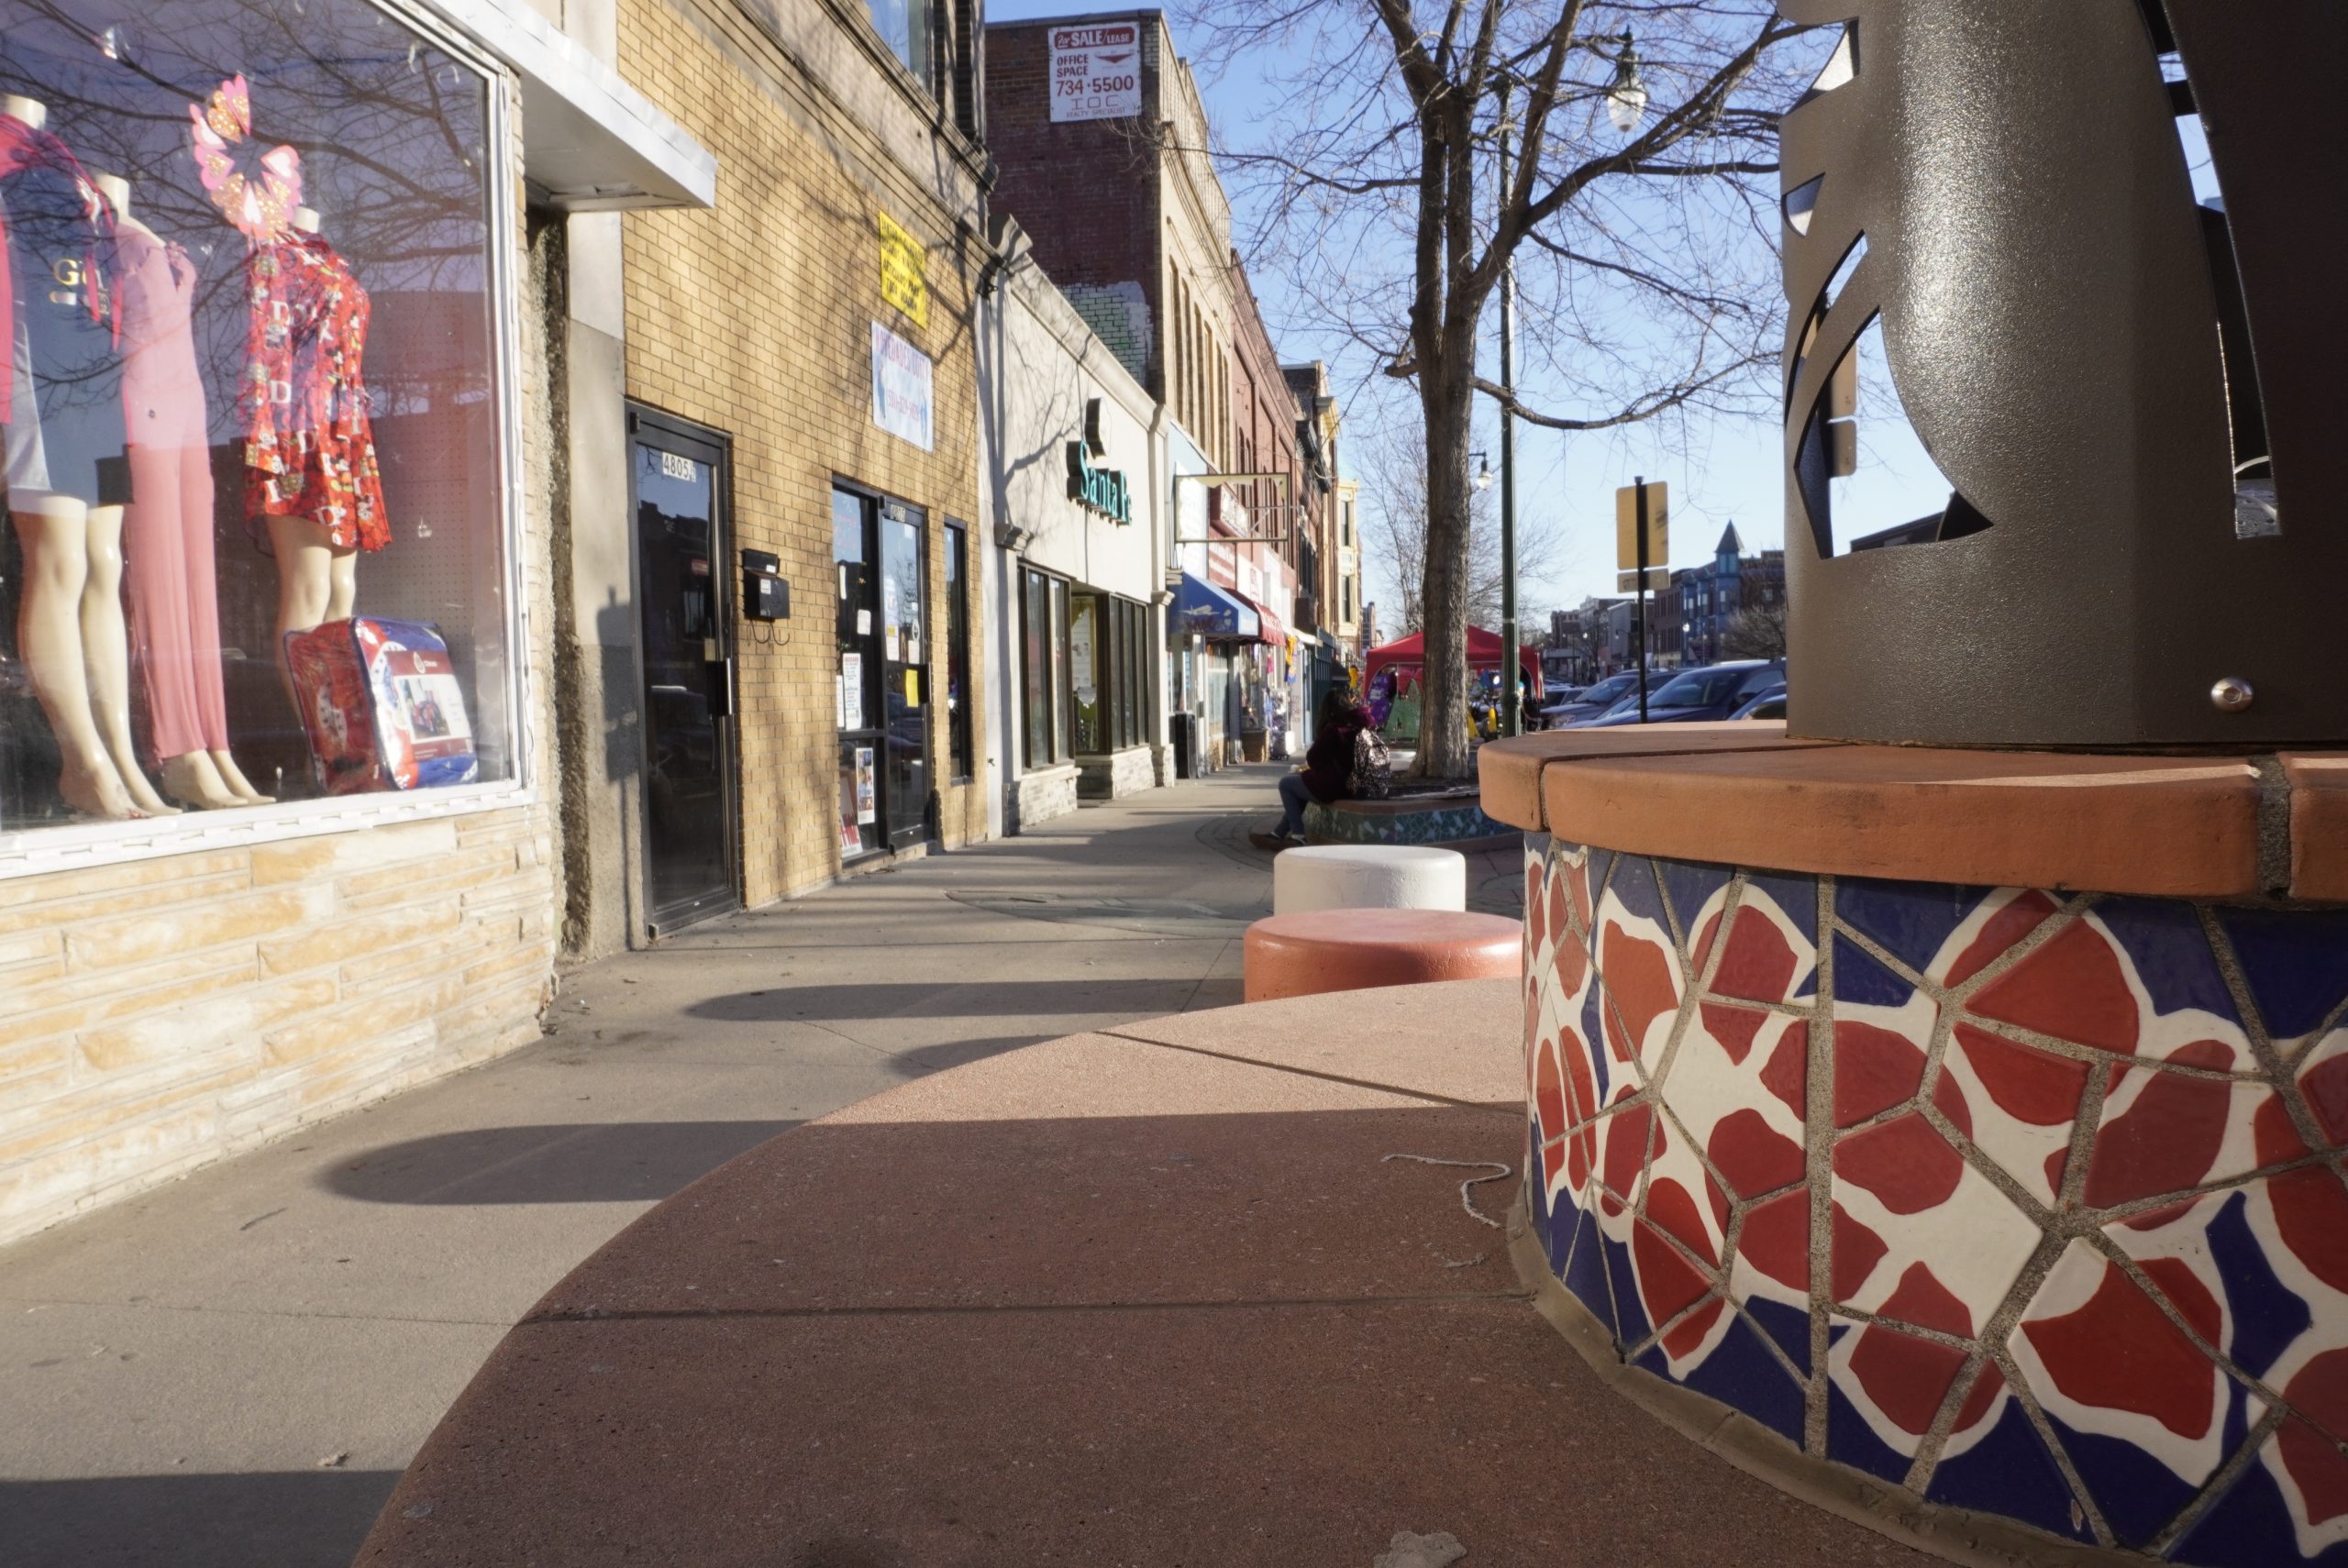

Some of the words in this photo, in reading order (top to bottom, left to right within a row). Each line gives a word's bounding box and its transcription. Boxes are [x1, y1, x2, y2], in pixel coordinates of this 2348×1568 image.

[1057, 54, 1089, 66] OFFICE
[1057, 66, 1089, 78] SPACE
[664, 455, 689, 478] 4805
[1080, 439, 1119, 519] Santa
